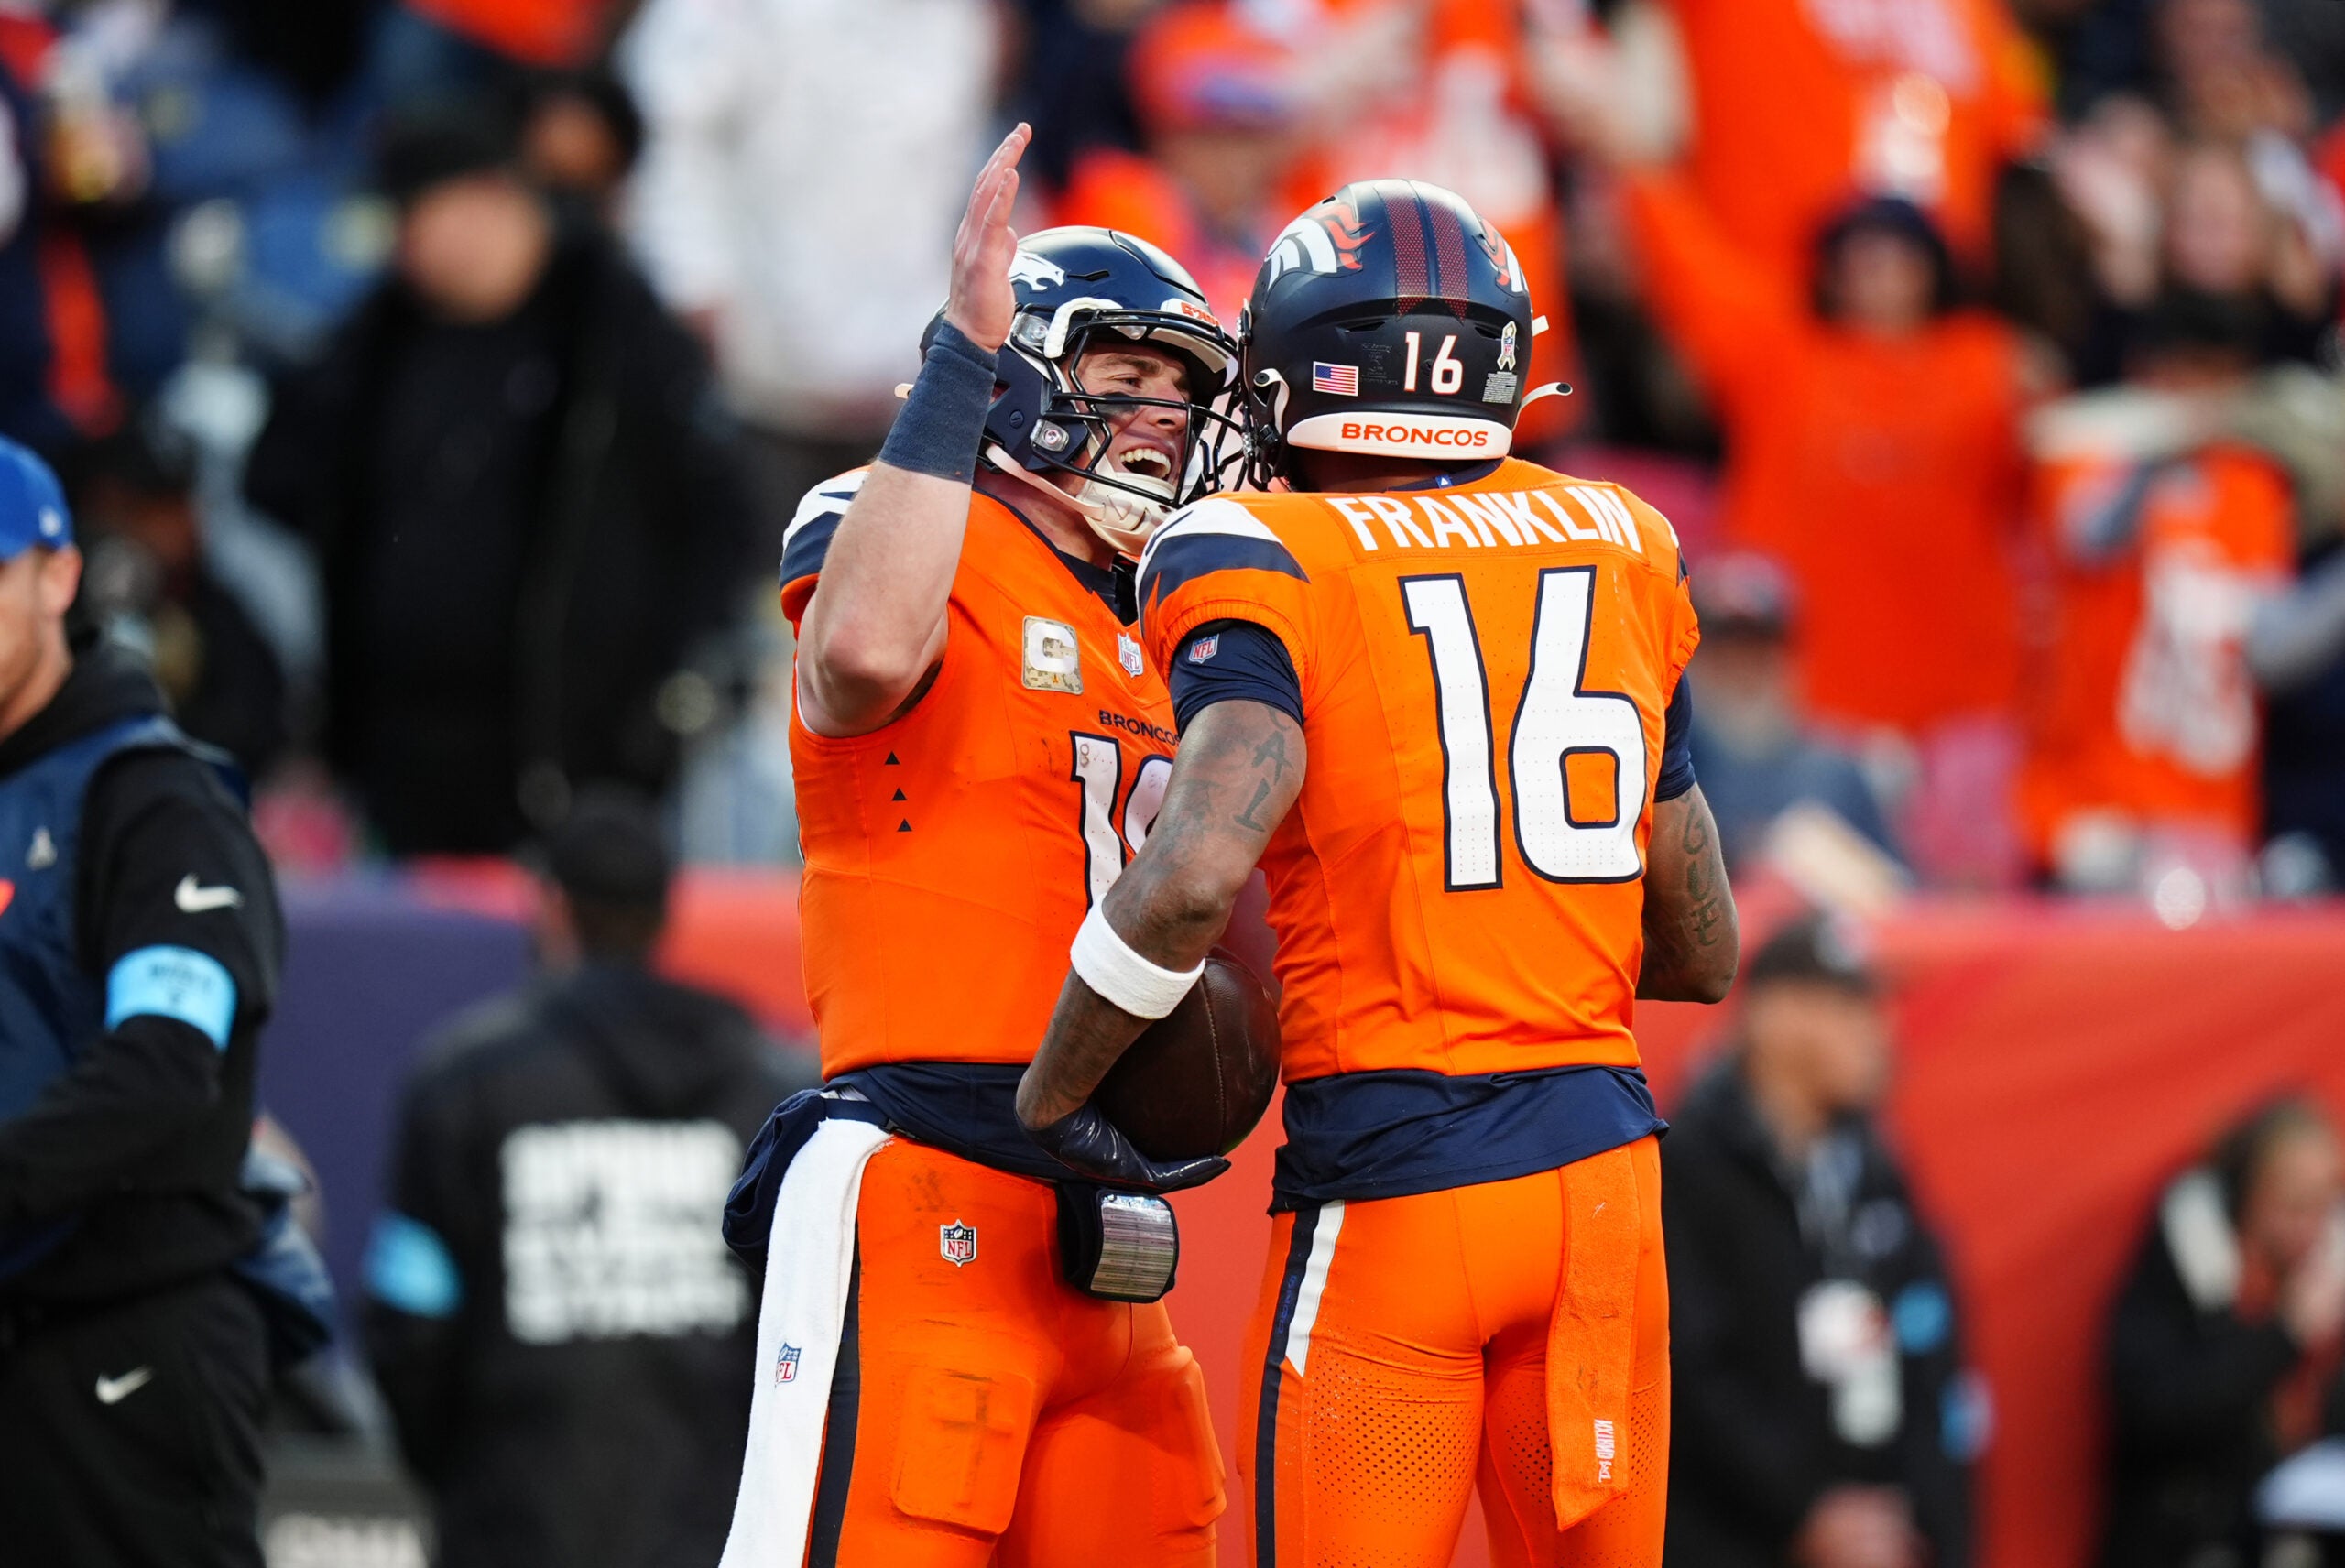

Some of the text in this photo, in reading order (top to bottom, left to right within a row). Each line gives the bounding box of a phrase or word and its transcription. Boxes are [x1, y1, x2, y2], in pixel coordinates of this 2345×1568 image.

[1403, 331, 1463, 394] 16
[1341, 423, 1489, 447] BRONCOS
[1325, 485, 1642, 551] FRANKLIN
[1027, 622, 1074, 674] C
[1397, 565, 1647, 893] 16
[947, 1240, 972, 1258] NFL
